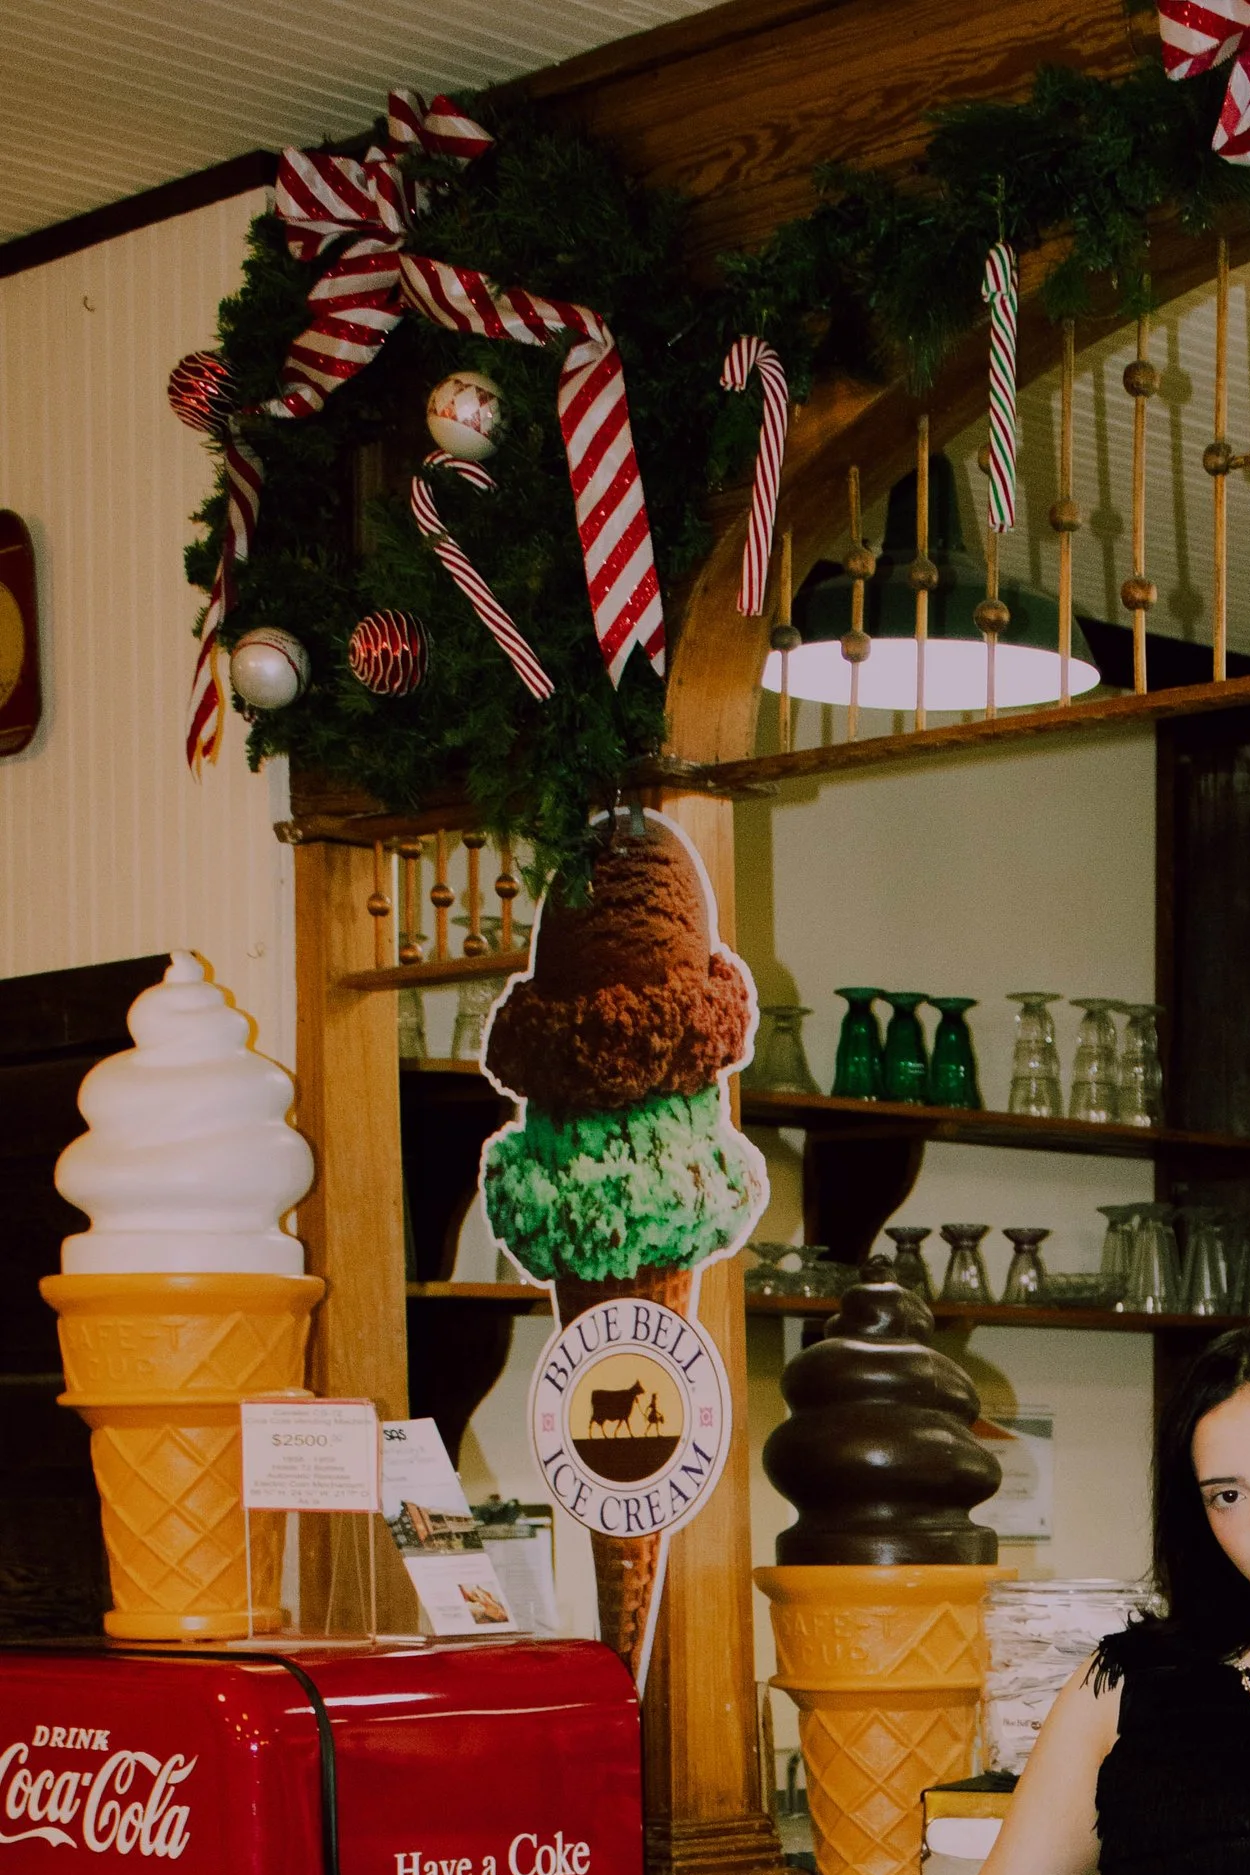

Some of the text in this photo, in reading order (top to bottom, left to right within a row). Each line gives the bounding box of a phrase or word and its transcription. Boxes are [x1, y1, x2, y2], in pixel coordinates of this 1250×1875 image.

[543, 1304, 705, 1394] BLUE BELL
[543, 1439, 713, 1533] ICE CREAM
[32, 1725, 110, 1751] DRINK
